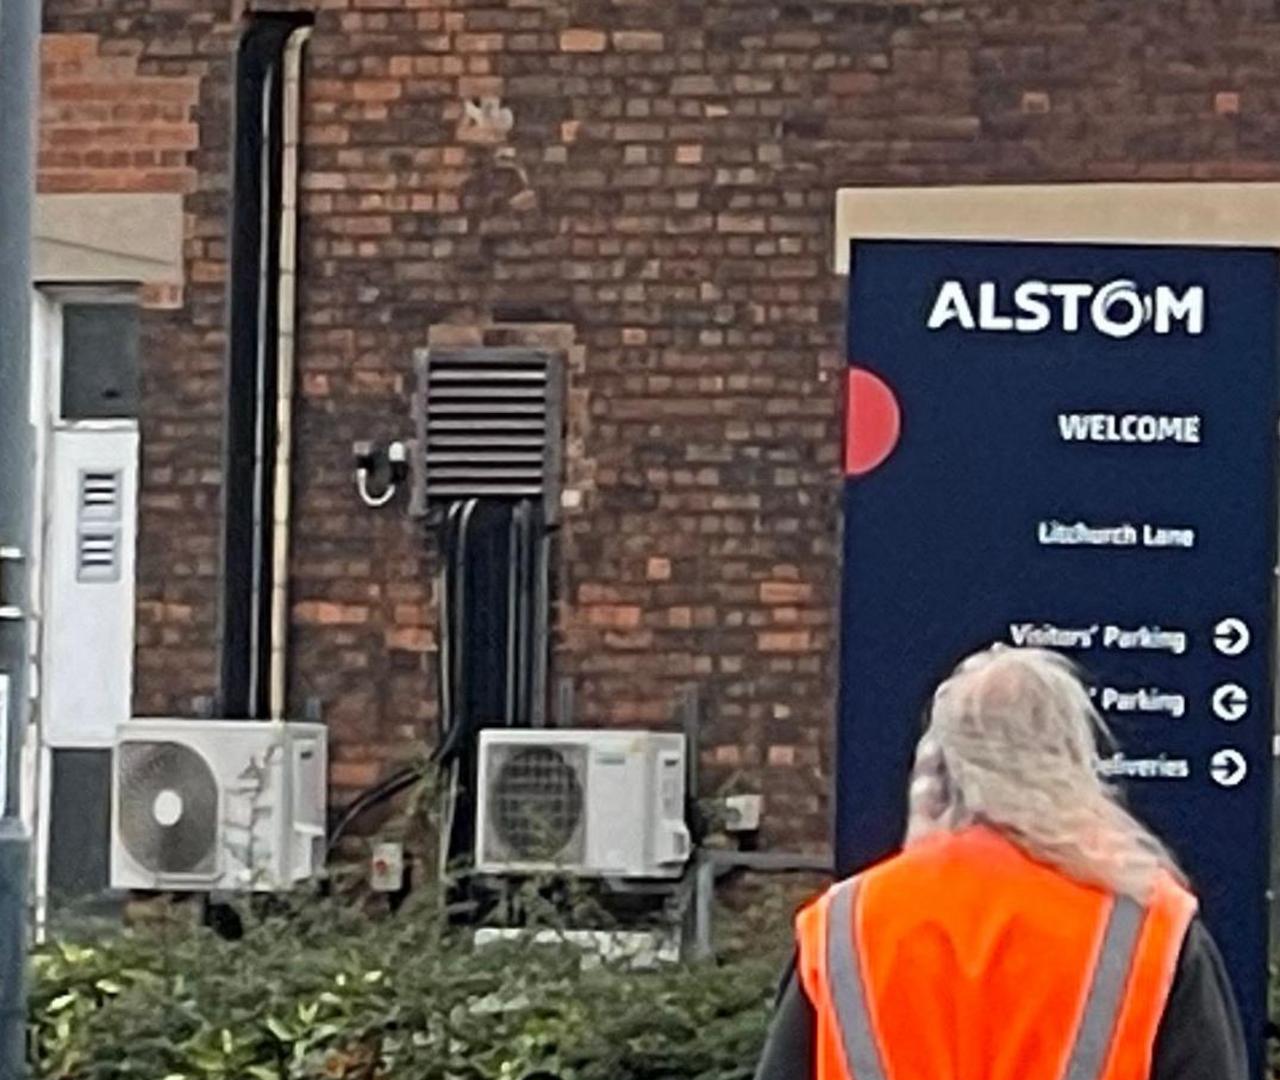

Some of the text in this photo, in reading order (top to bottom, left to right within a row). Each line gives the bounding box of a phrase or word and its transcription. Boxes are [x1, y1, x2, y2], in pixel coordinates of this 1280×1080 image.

[927, 280, 1204, 338] ALSTOM
[1058, 414, 1200, 443] WELCOME
[1143, 524, 1195, 547] Lane
[1103, 625, 1186, 654] Parking
[1102, 687, 1185, 717] Parking
[1096, 753, 1189, 778] eliveries
